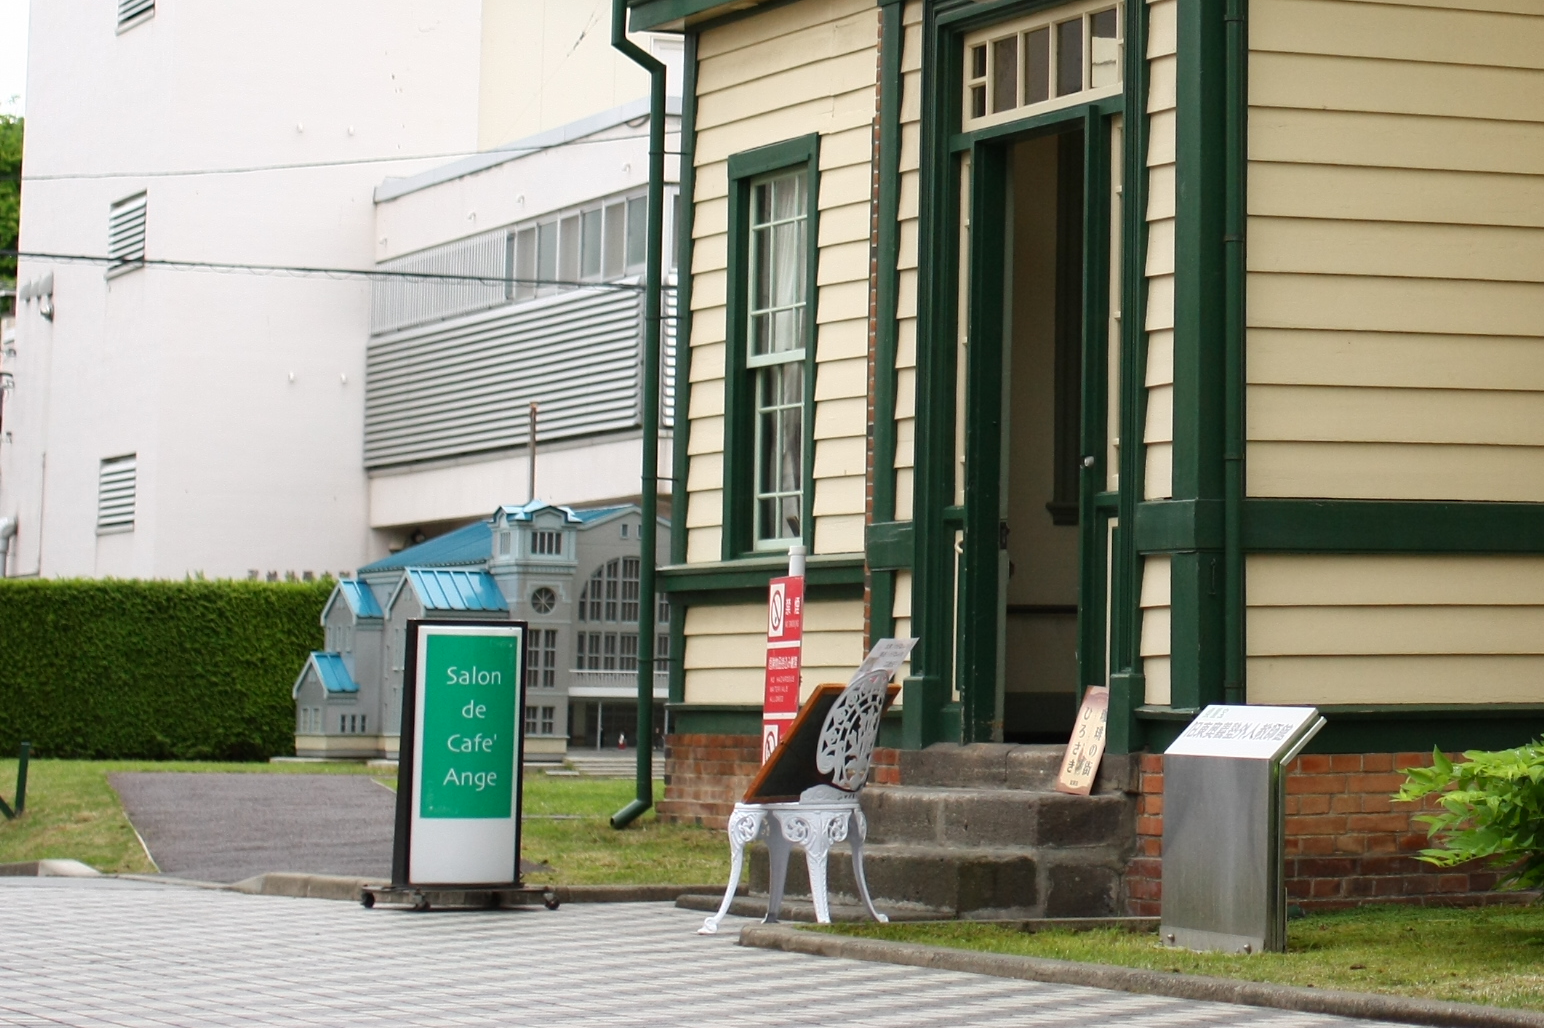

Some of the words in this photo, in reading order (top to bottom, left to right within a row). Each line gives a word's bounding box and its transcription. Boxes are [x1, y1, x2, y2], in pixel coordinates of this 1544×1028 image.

[446, 666, 502, 685] Salon
[461, 699, 487, 719] de
[447, 733, 497, 752] Cafe'
[1066, 707, 1093, 773] ひろさき
[443, 768, 497, 791] Ange
